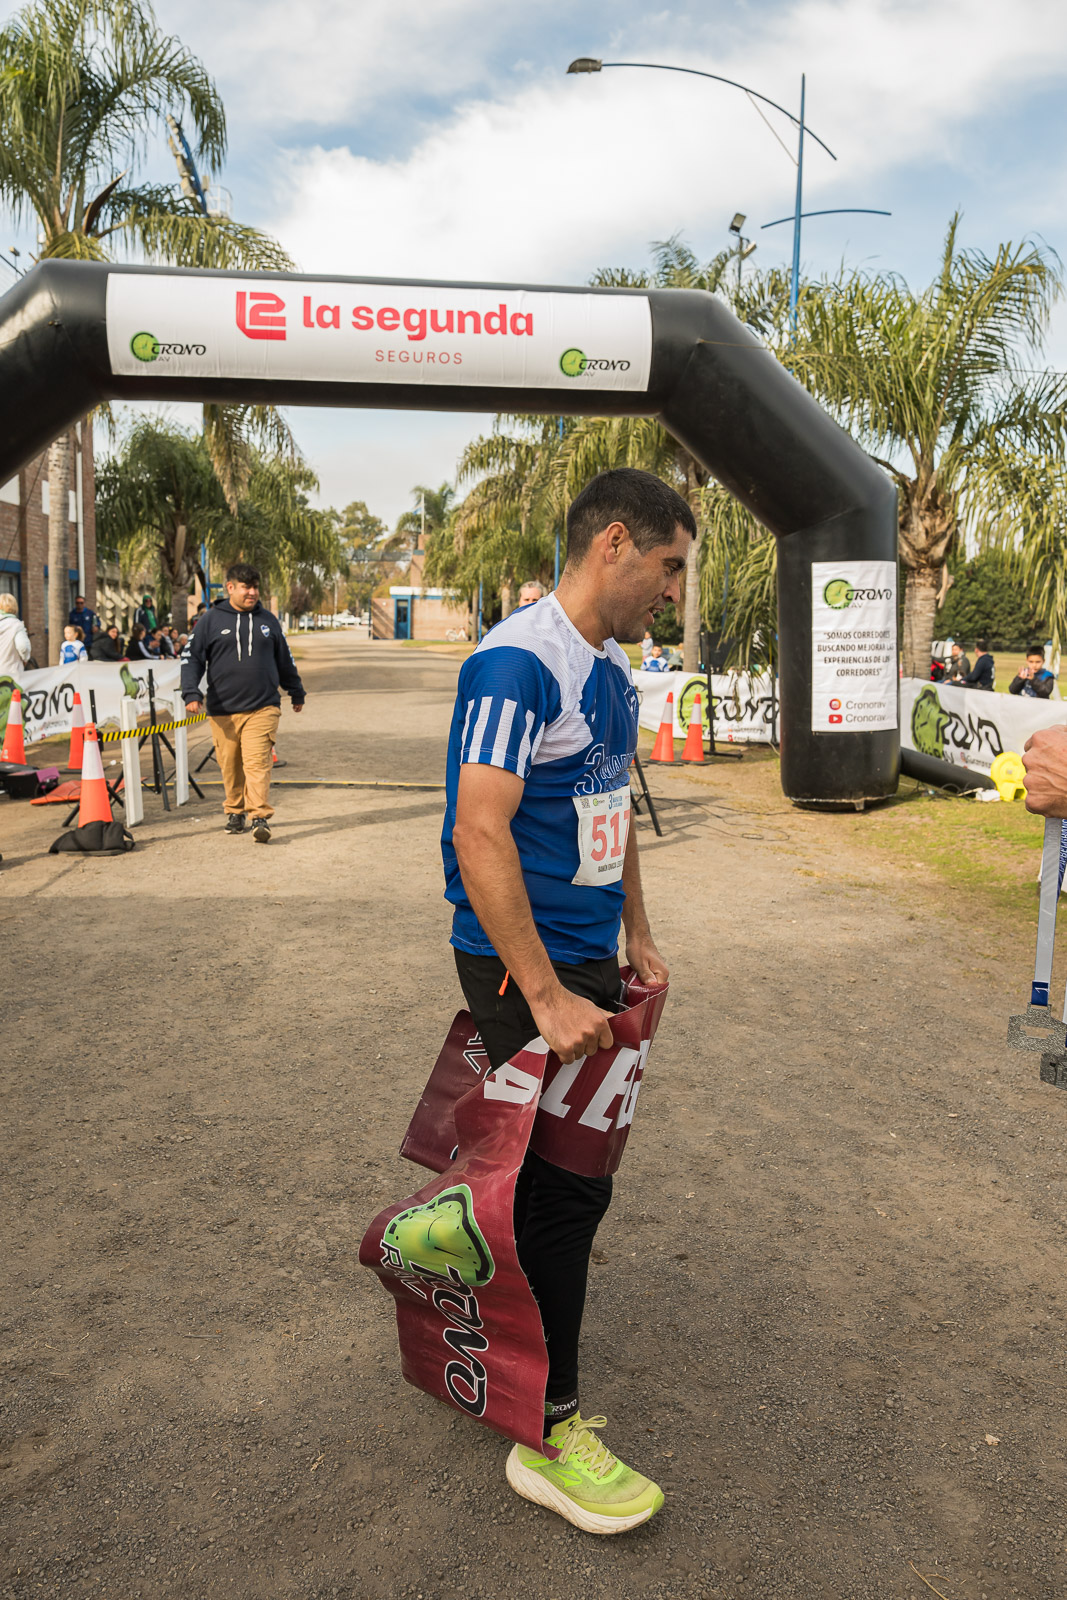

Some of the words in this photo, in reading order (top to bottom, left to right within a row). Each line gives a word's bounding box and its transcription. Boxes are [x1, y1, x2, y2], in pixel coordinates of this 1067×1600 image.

[303, 296, 340, 329] la
[351, 303, 533, 341] segunda
[375, 350, 463, 365] SEGUROS
[824, 656, 872, 664] EXPERIENCIAS
[846, 700, 886, 710] Cronorav
[846, 713, 886, 723] Cronorav
[591, 809, 630, 862] 517
